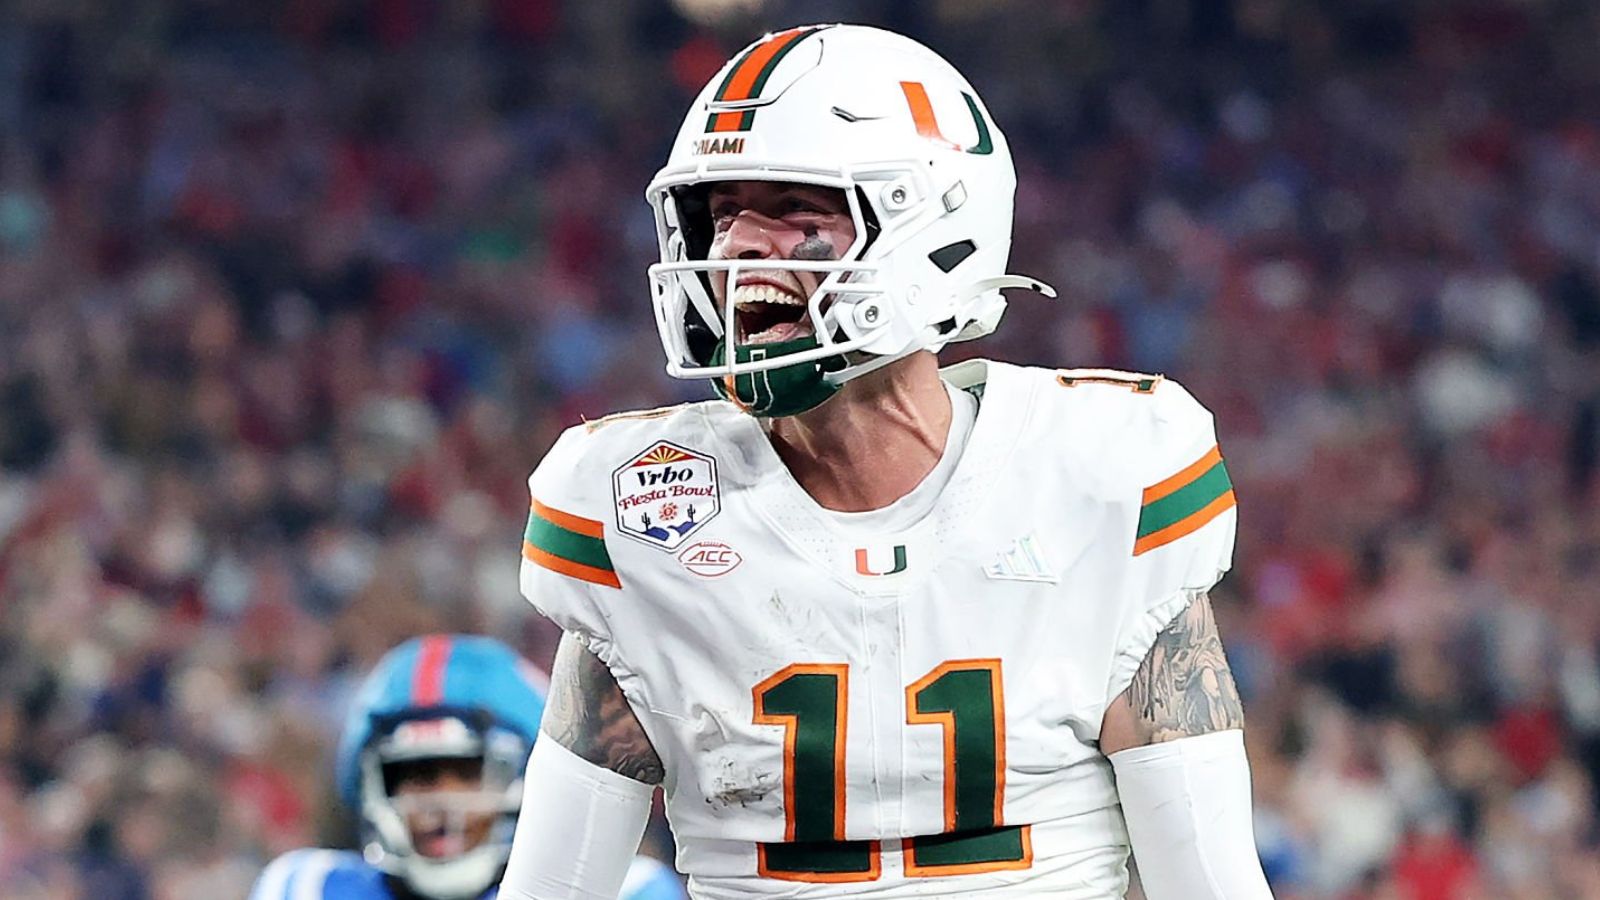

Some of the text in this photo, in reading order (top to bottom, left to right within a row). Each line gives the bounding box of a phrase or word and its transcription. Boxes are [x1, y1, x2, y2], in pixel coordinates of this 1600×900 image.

[899, 81, 993, 155] U
[637, 466, 693, 486] Vrbo
[618, 485, 715, 510] Fiesta Bowl
[688, 550, 732, 563] ACC
[855, 545, 907, 576] U
[752, 658, 1034, 883] 11
